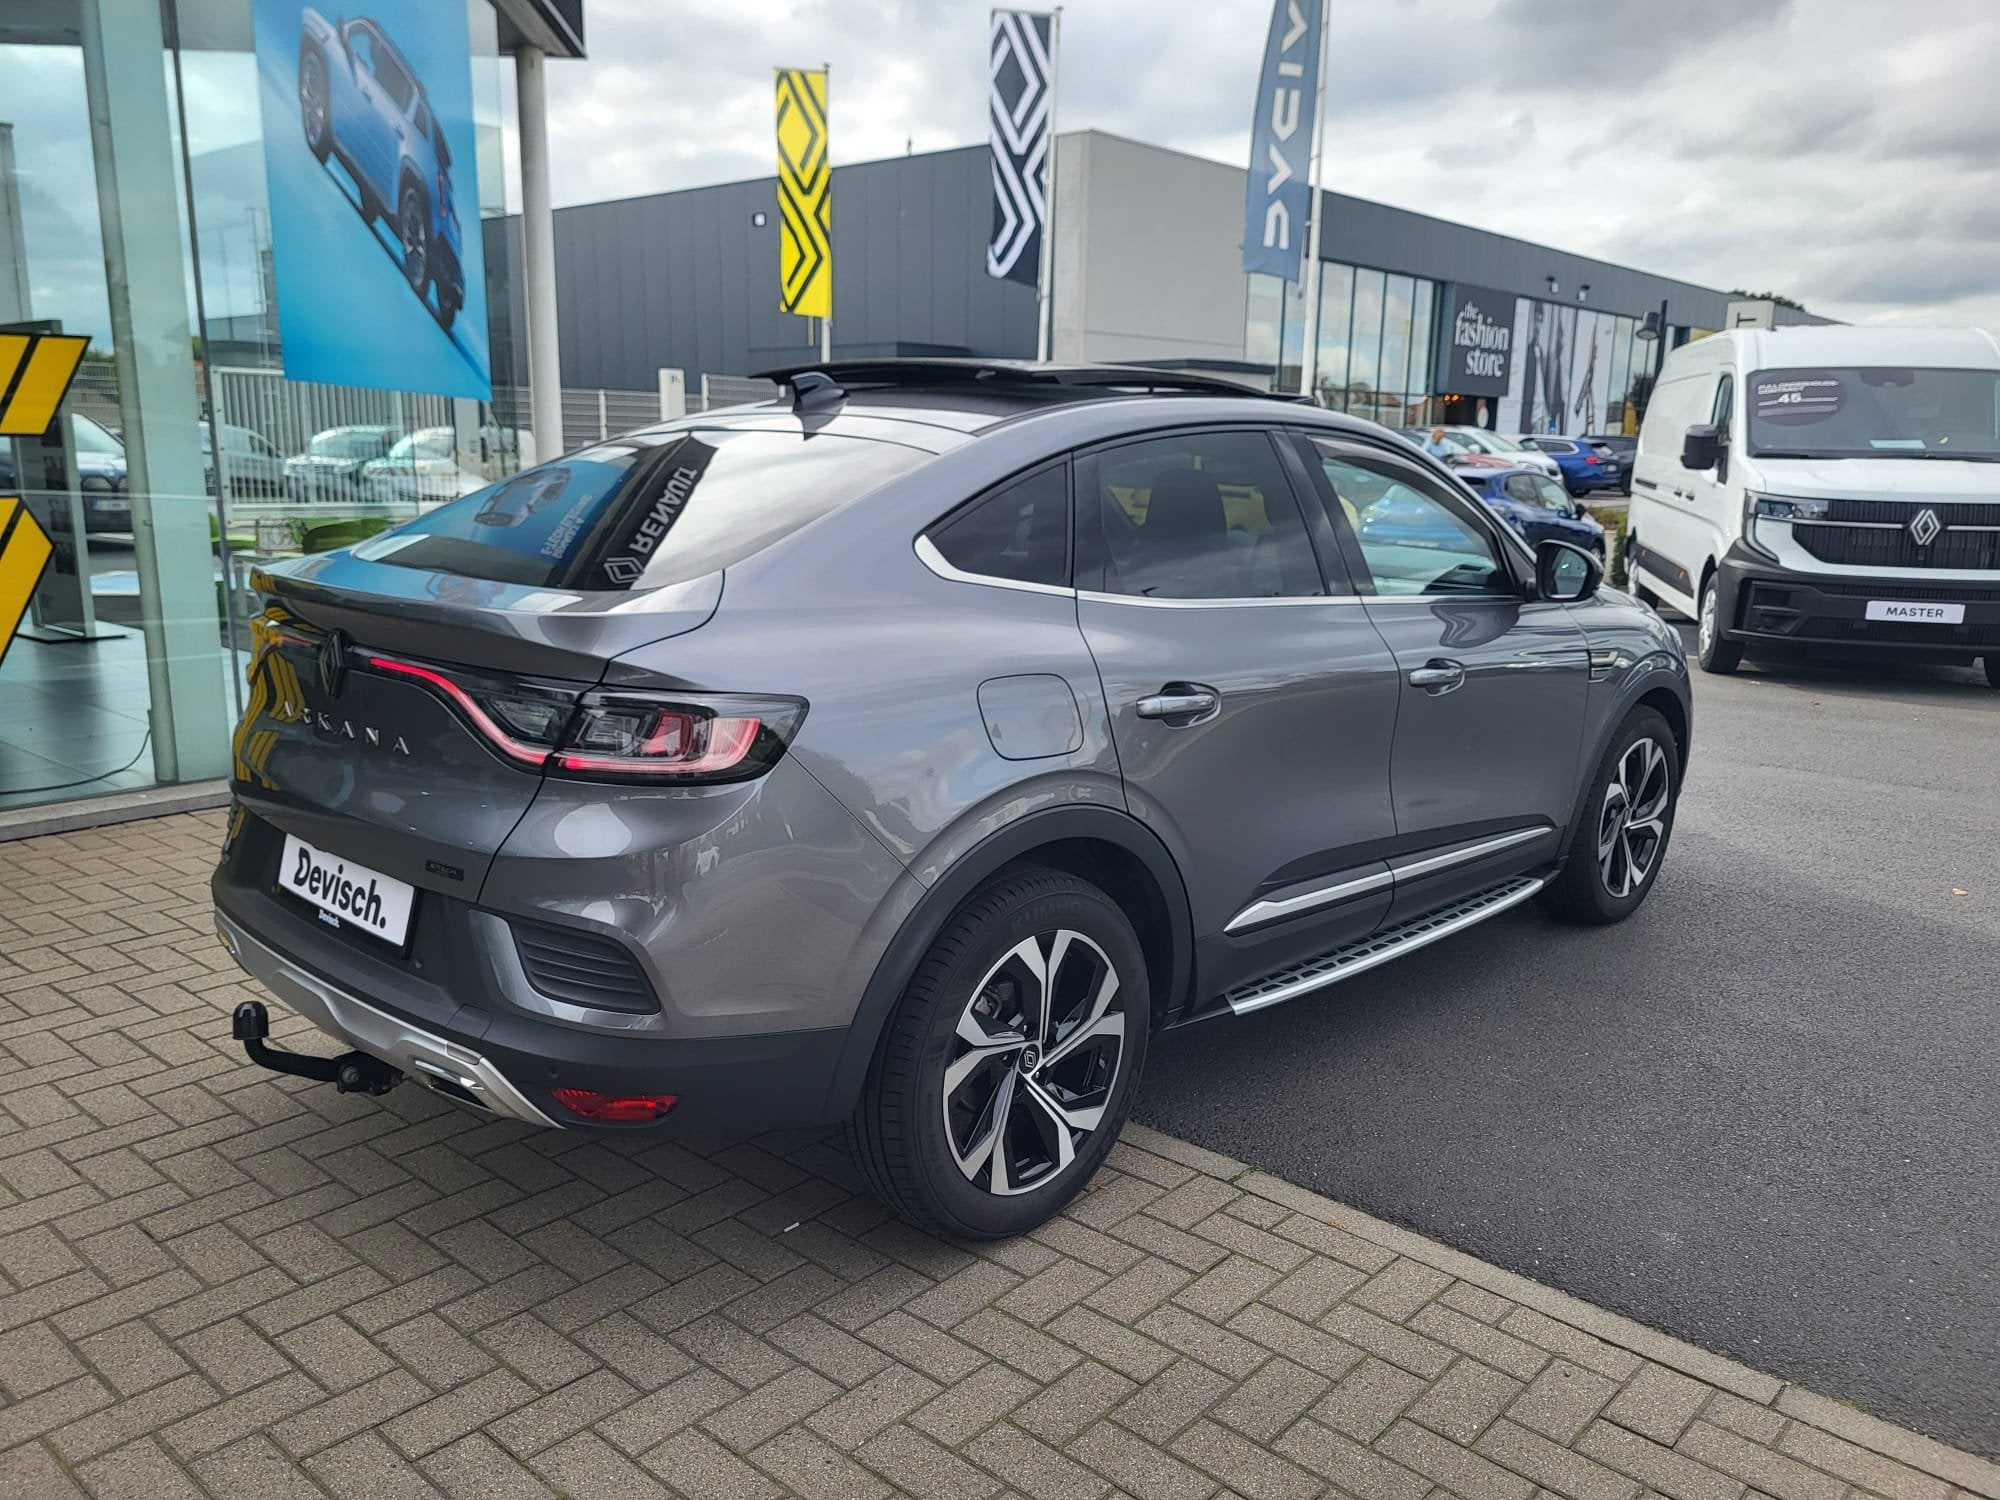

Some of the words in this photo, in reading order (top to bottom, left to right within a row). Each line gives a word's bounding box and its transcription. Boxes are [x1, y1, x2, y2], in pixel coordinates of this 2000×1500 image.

[1464, 301, 1479, 320] the
[1455, 311, 1509, 351] fashion
[1465, 348, 1504, 377] store
[1886, 607, 1944, 618] MASTER
[283, 700, 411, 756] ARKANA
[293, 846, 386, 929] Devisch.
